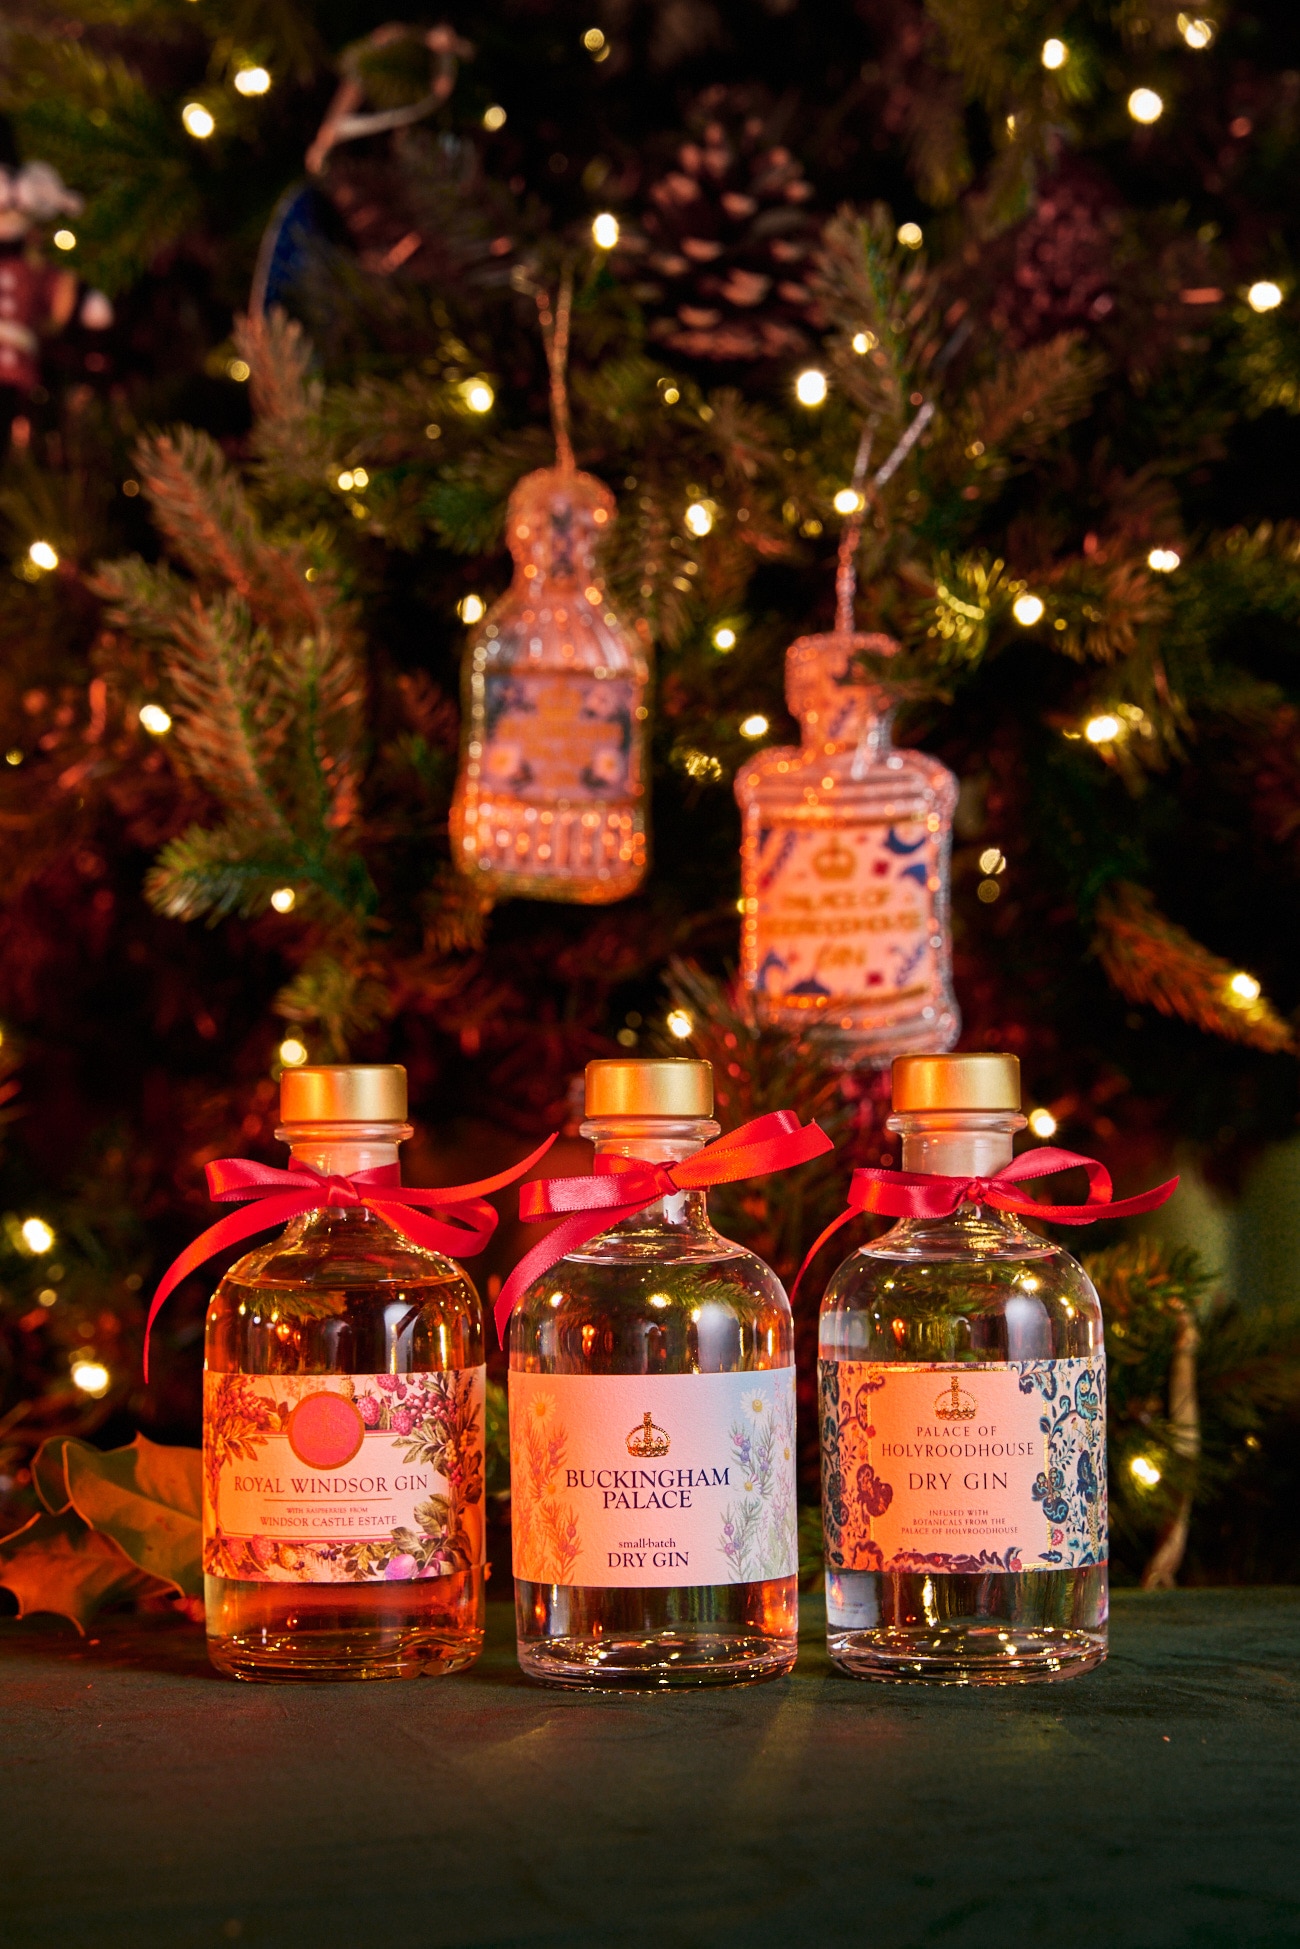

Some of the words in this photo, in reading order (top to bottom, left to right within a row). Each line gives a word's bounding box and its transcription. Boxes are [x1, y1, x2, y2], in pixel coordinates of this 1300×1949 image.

[916, 1426, 970, 1437] PALACE
[978, 1425, 997, 1437] OF
[881, 1441, 1034, 1458] HOLYROODHOUSE
[234, 1475, 285, 1493] ROYAL
[290, 1476, 388, 1493] WINDSOR
[394, 1474, 428, 1491] GIN
[565, 1467, 731, 1489] BUCKINGHAM
[909, 1472, 952, 1490] DRY
[963, 1471, 1008, 1490] GIN
[602, 1489, 693, 1510] PALACE
[259, 1516, 309, 1527] WINDSOR
[312, 1516, 354, 1527] CASTLE
[358, 1515, 398, 1526] ESTATE
[912, 1518, 962, 1526] BOTANICALS
[991, 1517, 1006, 1525] THE
[901, 1527, 929, 1535] PALACE
[931, 1527, 942, 1535] OF
[945, 1526, 1019, 1535] HOLYROODHOUSE
[618, 1537, 676, 1549] small-batch
[607, 1551, 647, 1568] DRY
[652, 1551, 690, 1568] GIN
